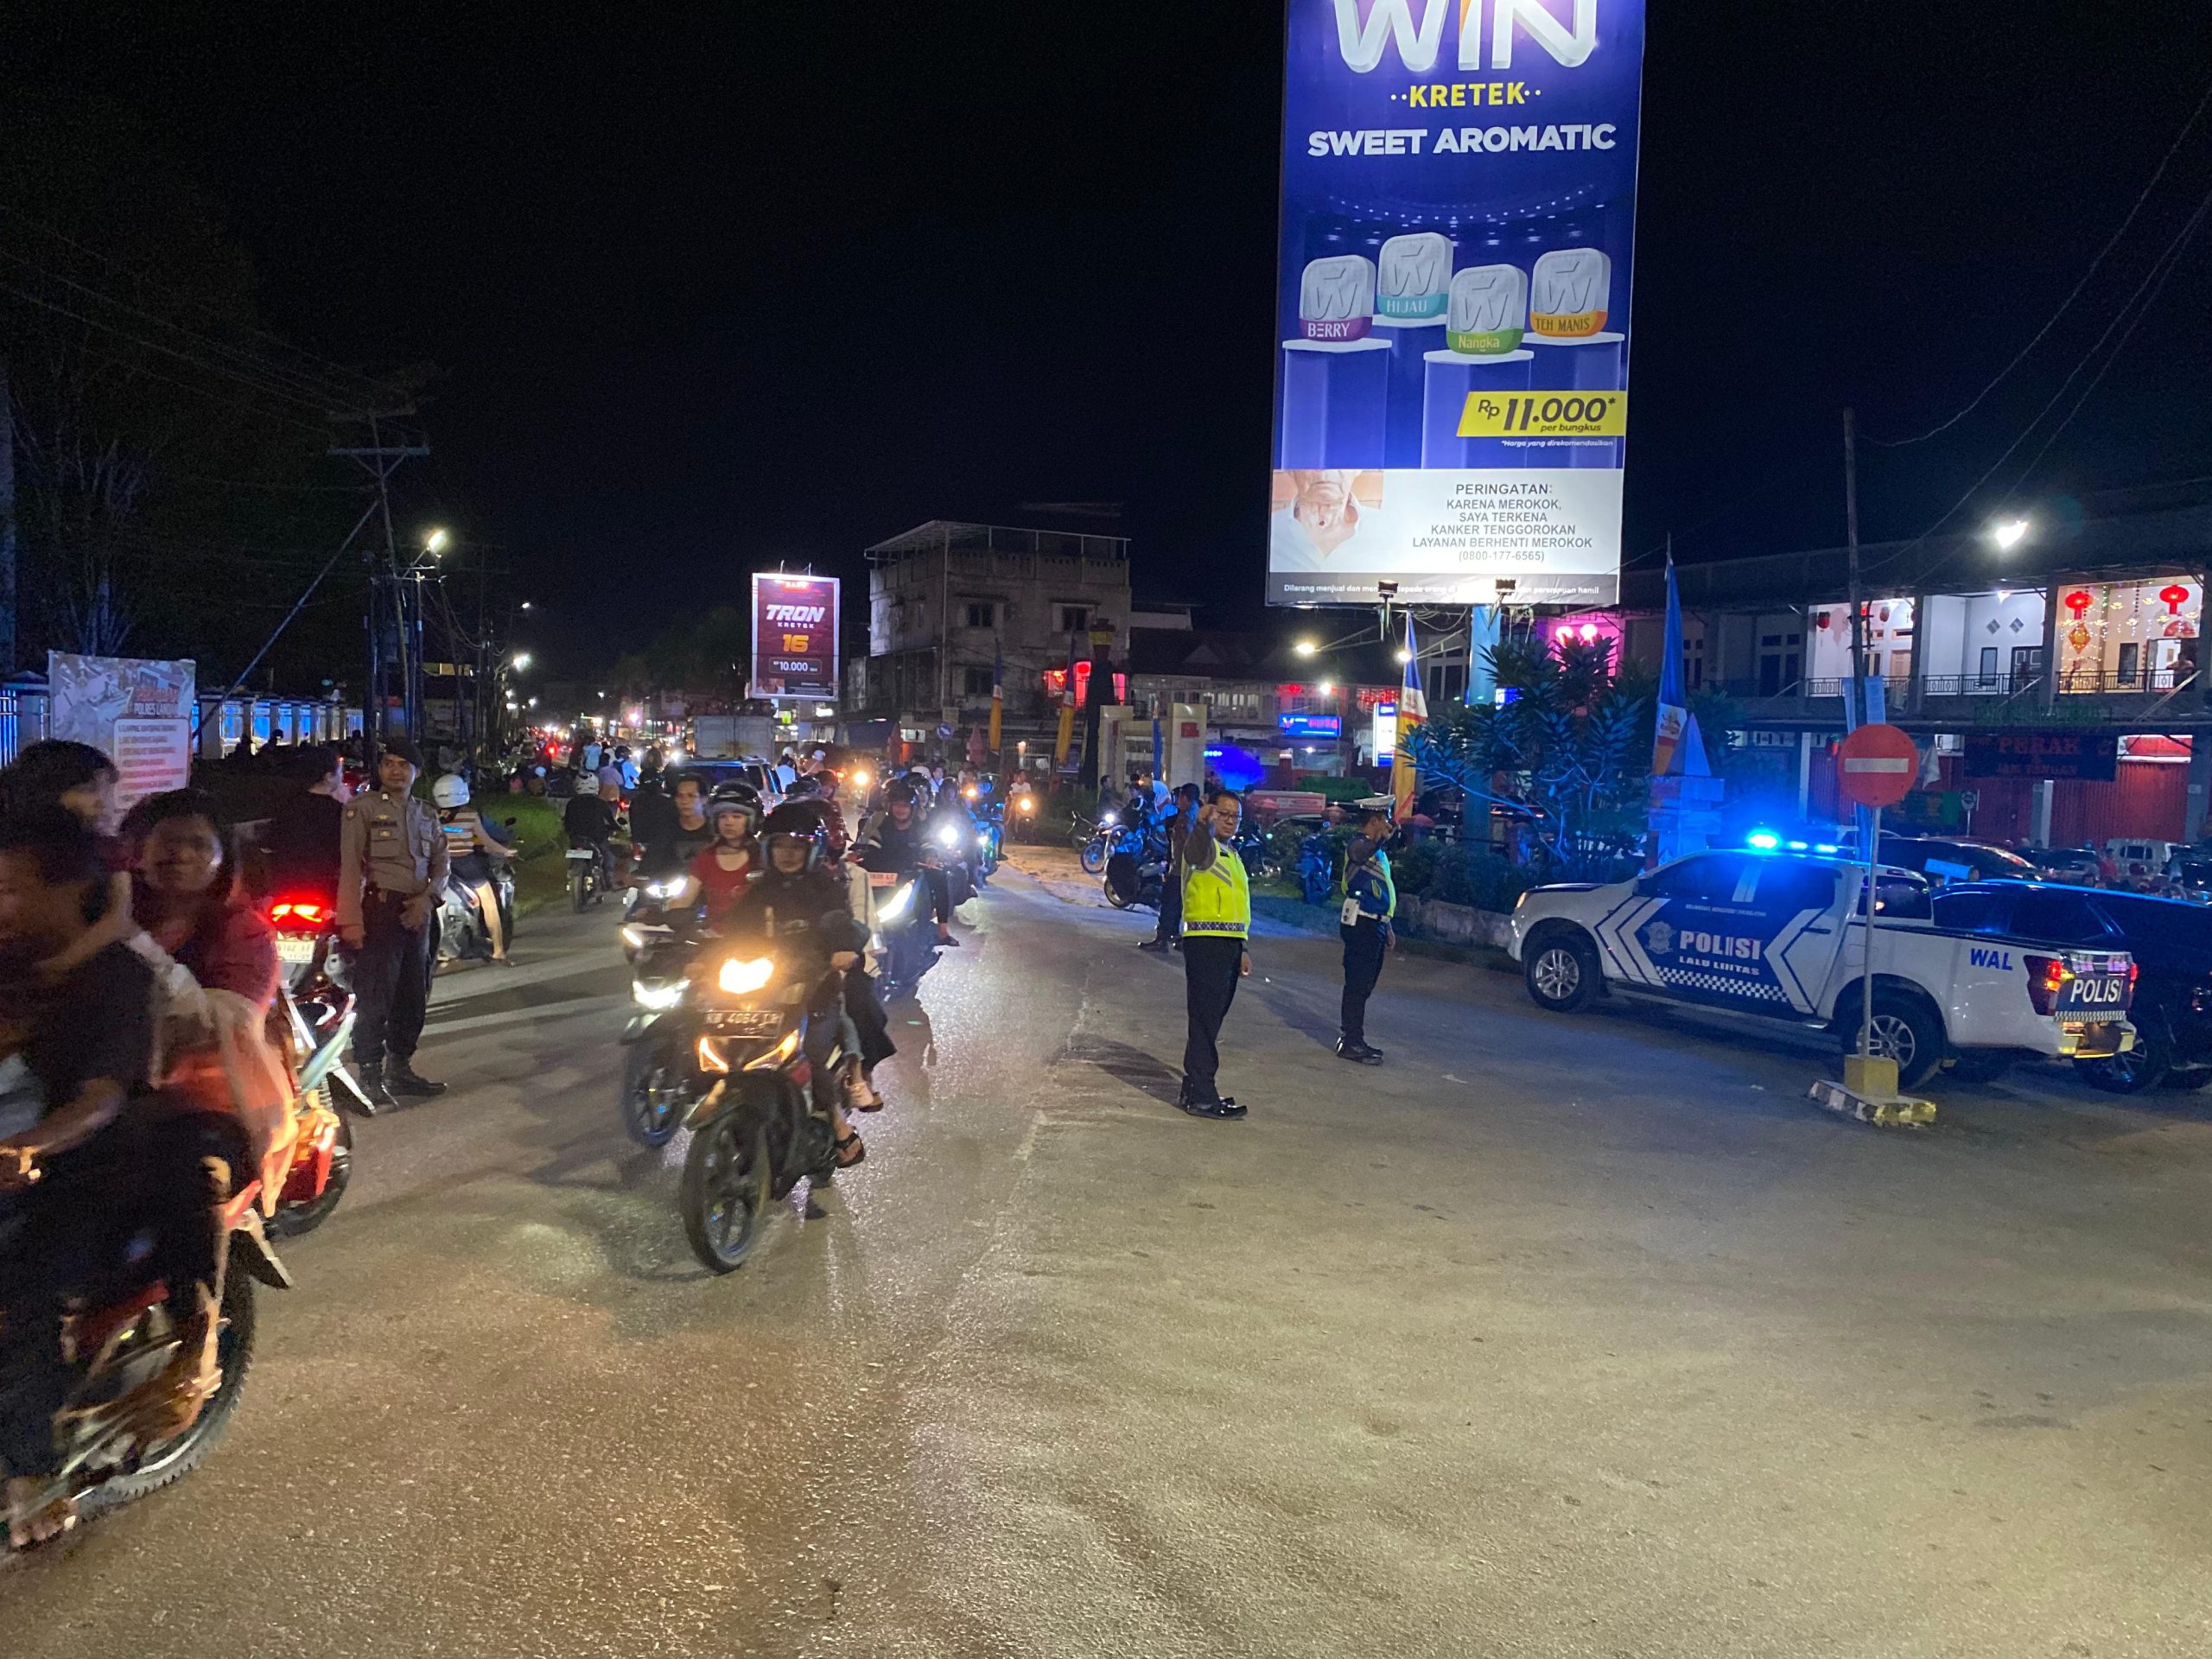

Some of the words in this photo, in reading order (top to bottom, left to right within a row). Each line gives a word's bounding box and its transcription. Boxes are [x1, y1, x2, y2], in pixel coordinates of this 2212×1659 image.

[1333, 0, 1598, 73] WIN
[1409, 82, 1526, 108] KRETEK
[1307, 129, 1428, 156] SWEET
[1433, 124, 1617, 154] AROMATIC
[1386, 299, 1428, 314] HIJAU
[1307, 322, 1351, 338] BERRY
[1535, 318, 1555, 332] TEH
[1557, 316, 1592, 332] MANIS
[1459, 334, 1501, 353] Nangka
[1478, 399, 1500, 420] Rp
[1541, 424, 1557, 433] per
[1559, 423, 1602, 433] bungkus
[1455, 483, 1554, 496] PERINGATAN:
[1446, 499, 1496, 510] KARENA
[1498, 499, 1562, 512] MEROKOK,
[1459, 512, 1490, 523] SAYA
[1494, 511, 1548, 523] TERKENA
[1431, 524, 1481, 536] KANKER
[1483, 524, 1576, 536] TENGGOROKAN
[1412, 537, 1466, 549] LAYANAN
[1469, 537, 1529, 549] BERHENTI
[1531, 537, 1592, 549] MEROKOK
[1459, 550, 1545, 563] (0800-177-6565)
[1284, 583, 1315, 594] Dilarang
[1316, 583, 1345, 594] menjual
[1346, 584, 1361, 593] dan
[1578, 586, 1599, 594] hamil
[766, 604, 826, 623] TRON
[782, 633, 810, 653] 16
[779, 661, 809, 671] 10.000
[1679, 930, 1761, 960] POLISI
[1679, 955, 1711, 968] LALU
[1713, 961, 1761, 976] LINTAS
[1970, 947, 2013, 971] WAL
[2069, 978, 2124, 1003] POLISI
